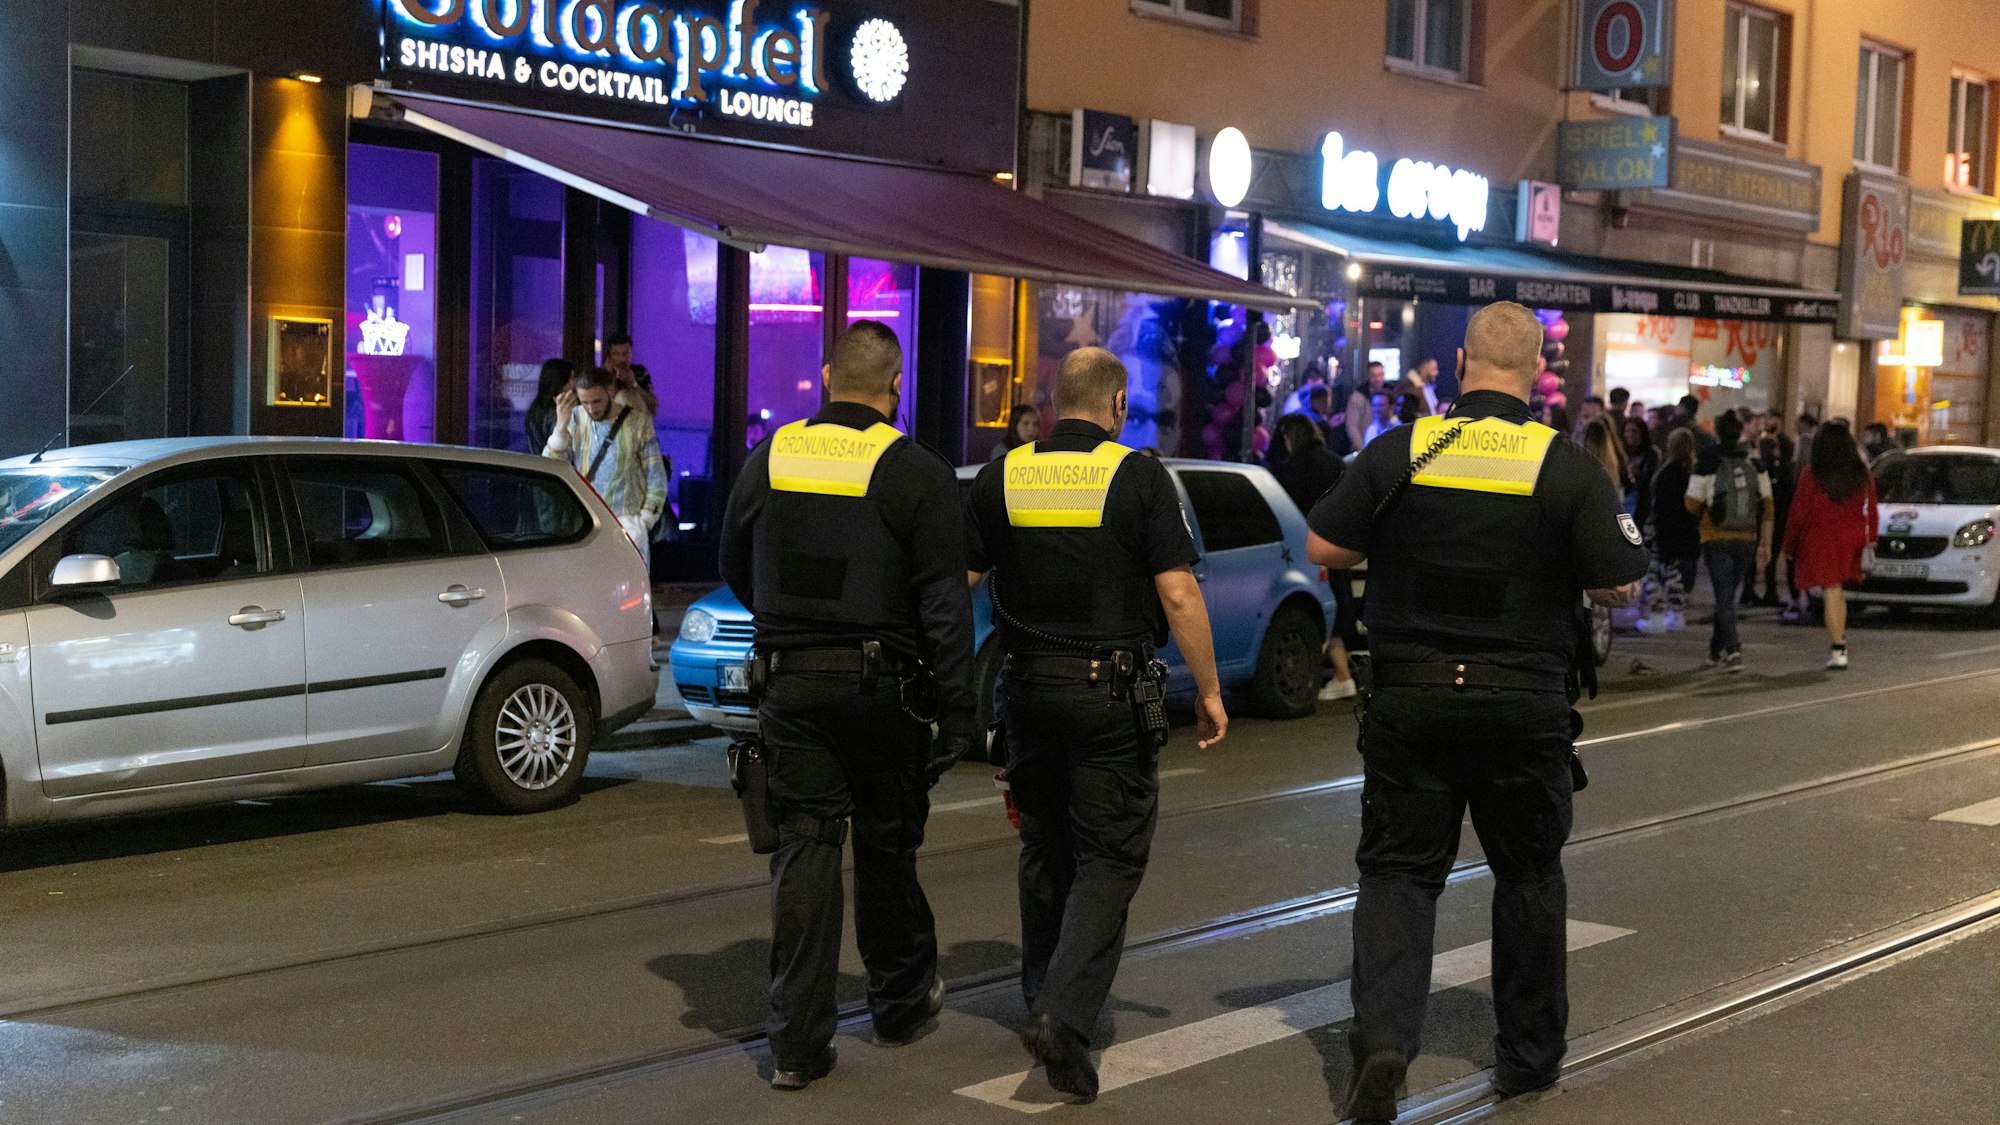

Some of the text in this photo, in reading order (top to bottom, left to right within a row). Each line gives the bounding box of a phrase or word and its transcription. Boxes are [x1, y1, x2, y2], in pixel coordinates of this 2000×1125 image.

[392, 0, 830, 100] oldapfel
[401, 37, 669, 105] SHISHA & COCKTAIL
[720, 89, 814, 127] LOUNGE
[1566, 124, 1639, 150] SPIEL
[1565, 157, 1654, 183] SALON
[1468, 278, 1496, 298] BAR
[1516, 281, 1591, 304] BIERGARTEN
[1673, 292, 1701, 311] CLUB
[776, 436, 876, 460] ORDNUNGSAMT
[1008, 466, 1108, 486] ORDNUNGSAMT
